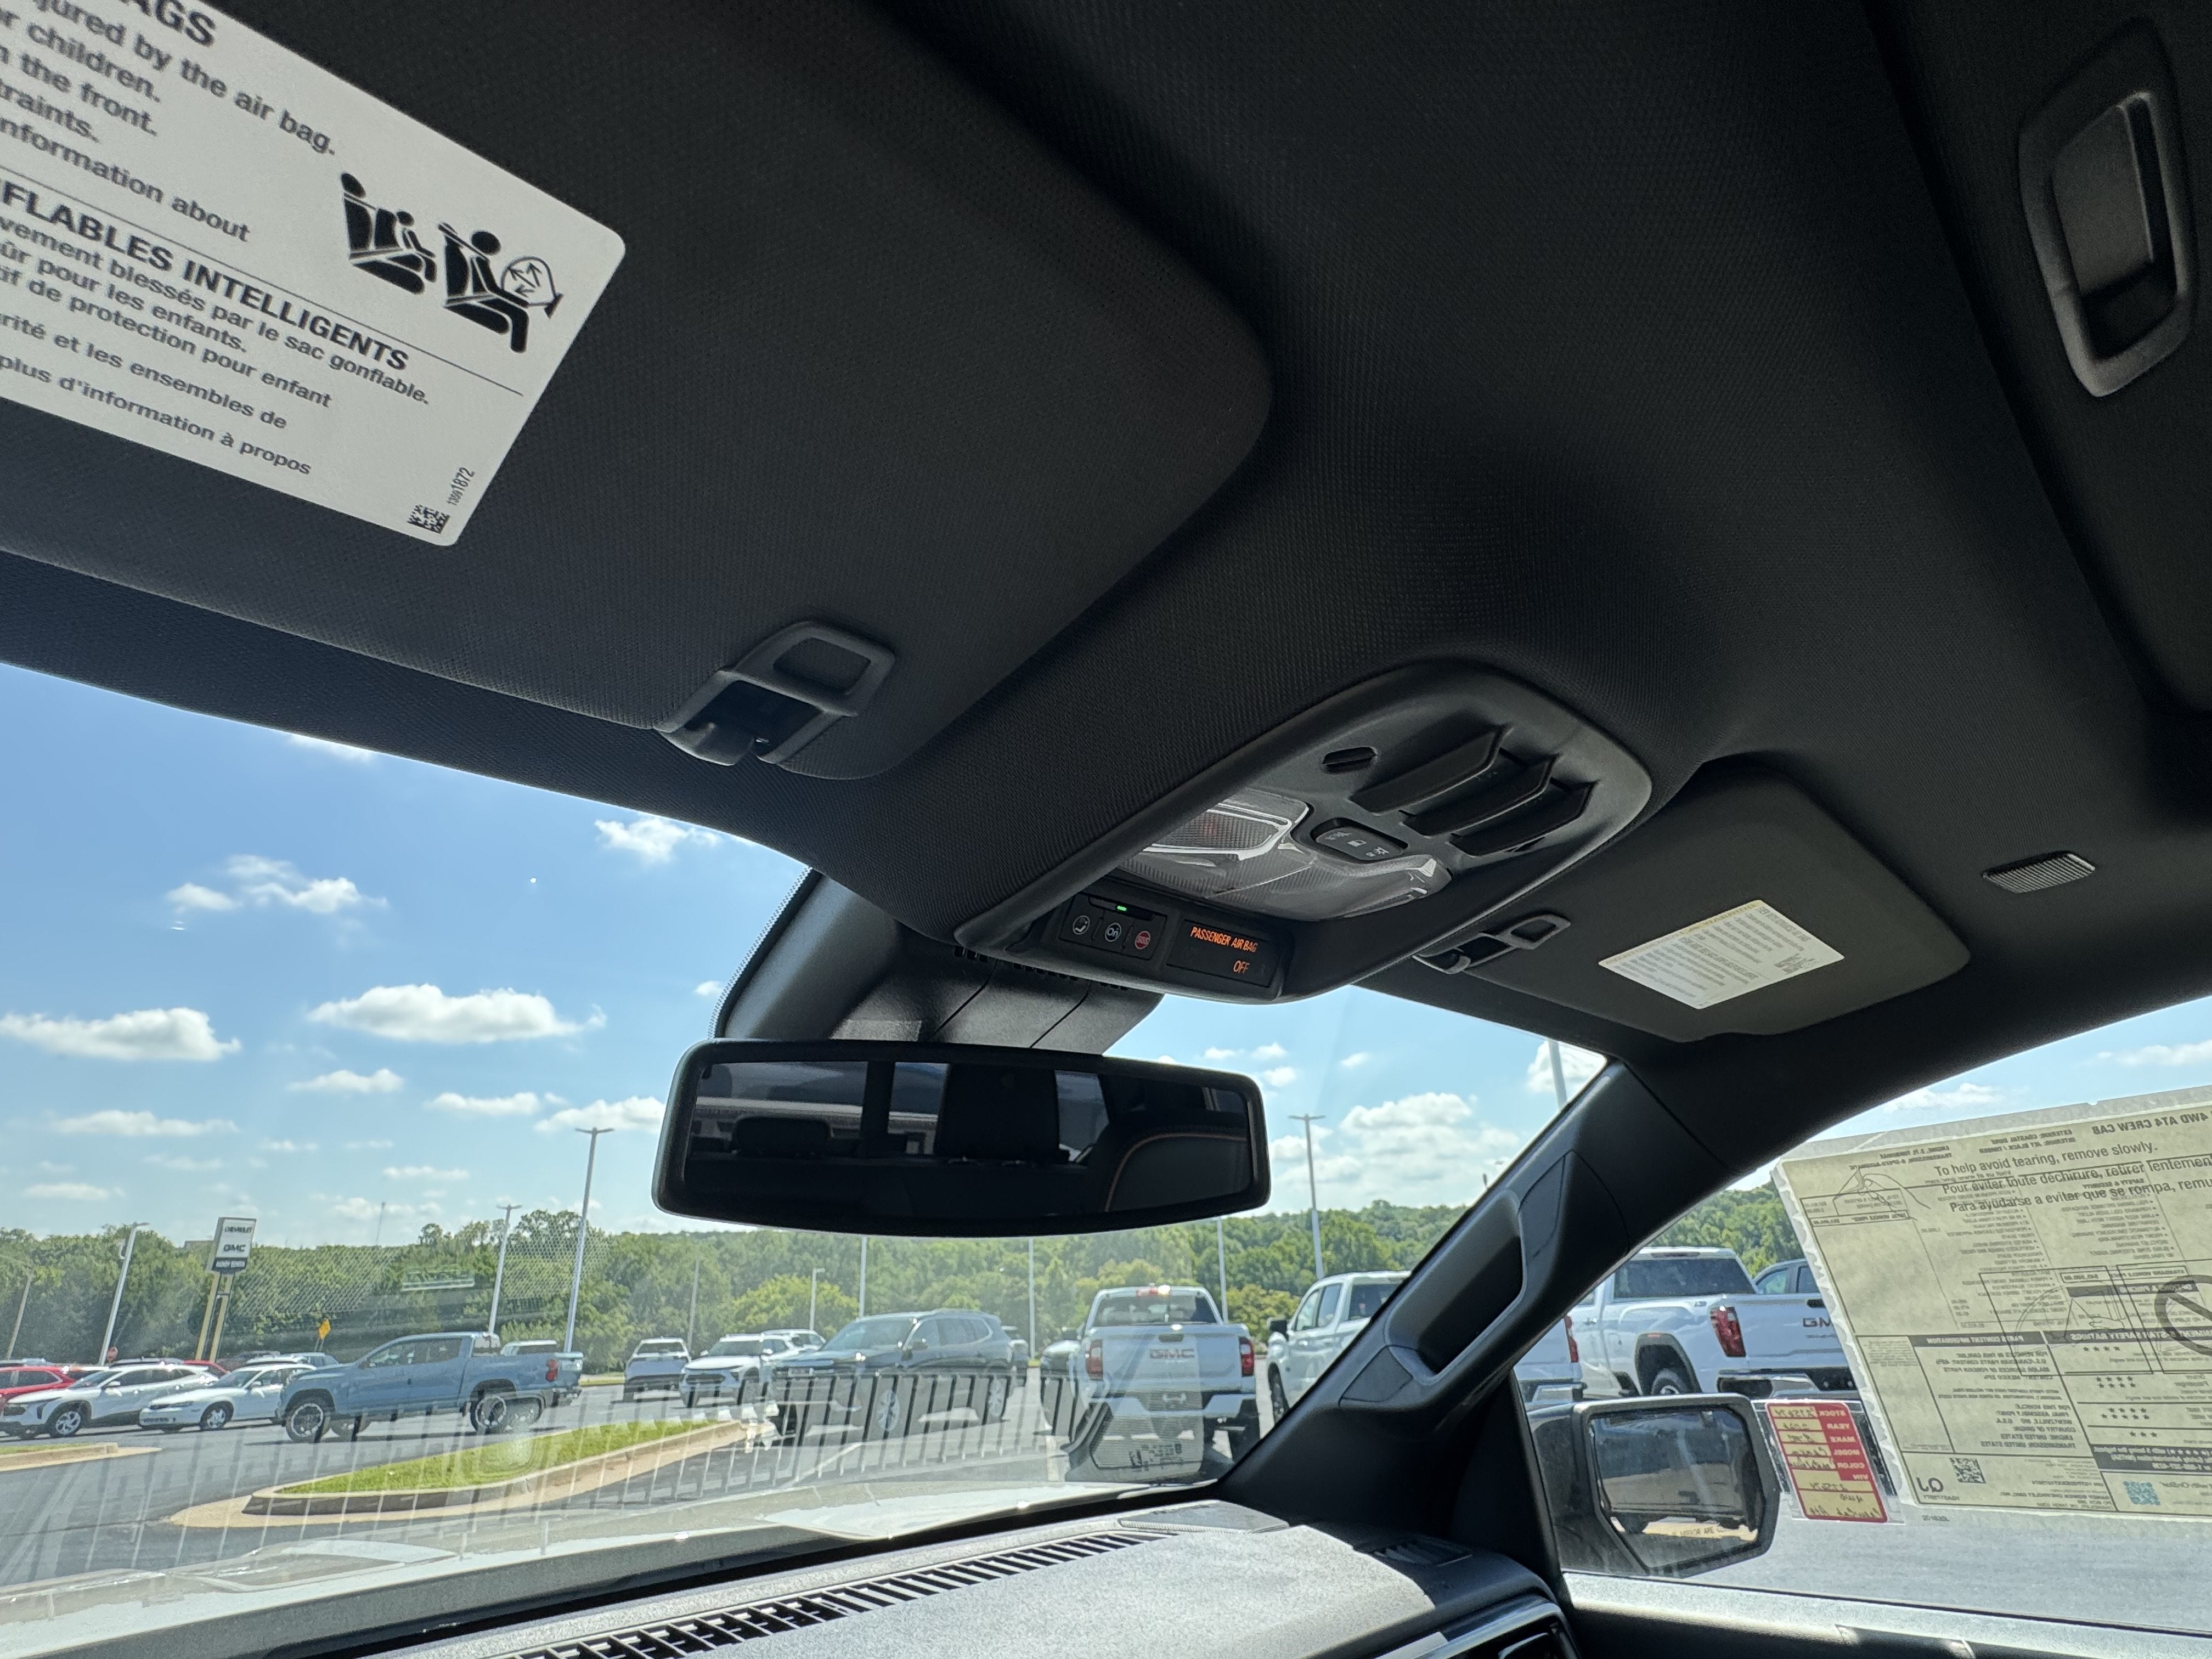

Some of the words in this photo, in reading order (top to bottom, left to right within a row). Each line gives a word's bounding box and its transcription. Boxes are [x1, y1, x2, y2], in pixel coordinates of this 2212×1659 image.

[19, 51, 72, 93] the
[79, 82, 158, 137] front.
[27, 21, 161, 103] children.
[133, 33, 172, 72] by
[180, 57, 228, 99] the
[234, 90, 275, 120] air
[278, 109, 335, 155] bag.
[171, 195, 251, 243] about
[28, 278, 63, 303] de
[68, 295, 196, 356] protection
[201, 346, 257, 377] pour
[261, 369, 333, 409] enfant
[36, 257, 103, 293] pour
[106, 283, 145, 311] les
[151, 303, 247, 353] enfants.
[109, 258, 206, 312] blessés
[210, 304, 254, 330] par
[257, 321, 280, 342] le
[283, 334, 325, 361] sac
[329, 353, 429, 405] gonflable.
[182, 259, 409, 371] INTELLIGENTS
[0, 352, 53, 383] plus
[59, 375, 215, 441] d'information
[220, 432, 235, 448] à
[239, 441, 312, 475] propos
[53, 334, 81, 353] et
[86, 342, 123, 369] les
[128, 359, 256, 417] ensembles
[259, 408, 287, 430] de
[1107, 927, 1120, 938] On
[1136, 936, 1149, 945] SOS
[1189, 926, 1231, 946] PASSENGER
[1231, 936, 1243, 950] AIR
[1243, 939, 1258, 953] BAG
[1233, 960, 1250, 974] OFF
[1934, 1165, 1949, 1177] To
[1951, 1163, 1977, 1177] help
[1980, 1158, 2011, 1171] avoid
[2013, 1153, 2060, 1169] tearing,
[2062, 1147, 2109, 1161] remove
[2111, 1141, 2158, 1156] slowly.
[1943, 1182, 1968, 1195] Pour
[2006, 1174, 2039, 1187] toute
[2106, 1161, 2145, 1177] retirer
[1950, 1200, 1978, 1212] Para
[1979, 1194, 2033, 1211] ayudarse
[2034, 1196, 2044, 1205] a
[2045, 1189, 2080, 1203] evitar
[2082, 1189, 2108, 1202] que
[2109, 1186, 2125, 1198] se
[2128, 1182, 2176, 1197] rompa,
